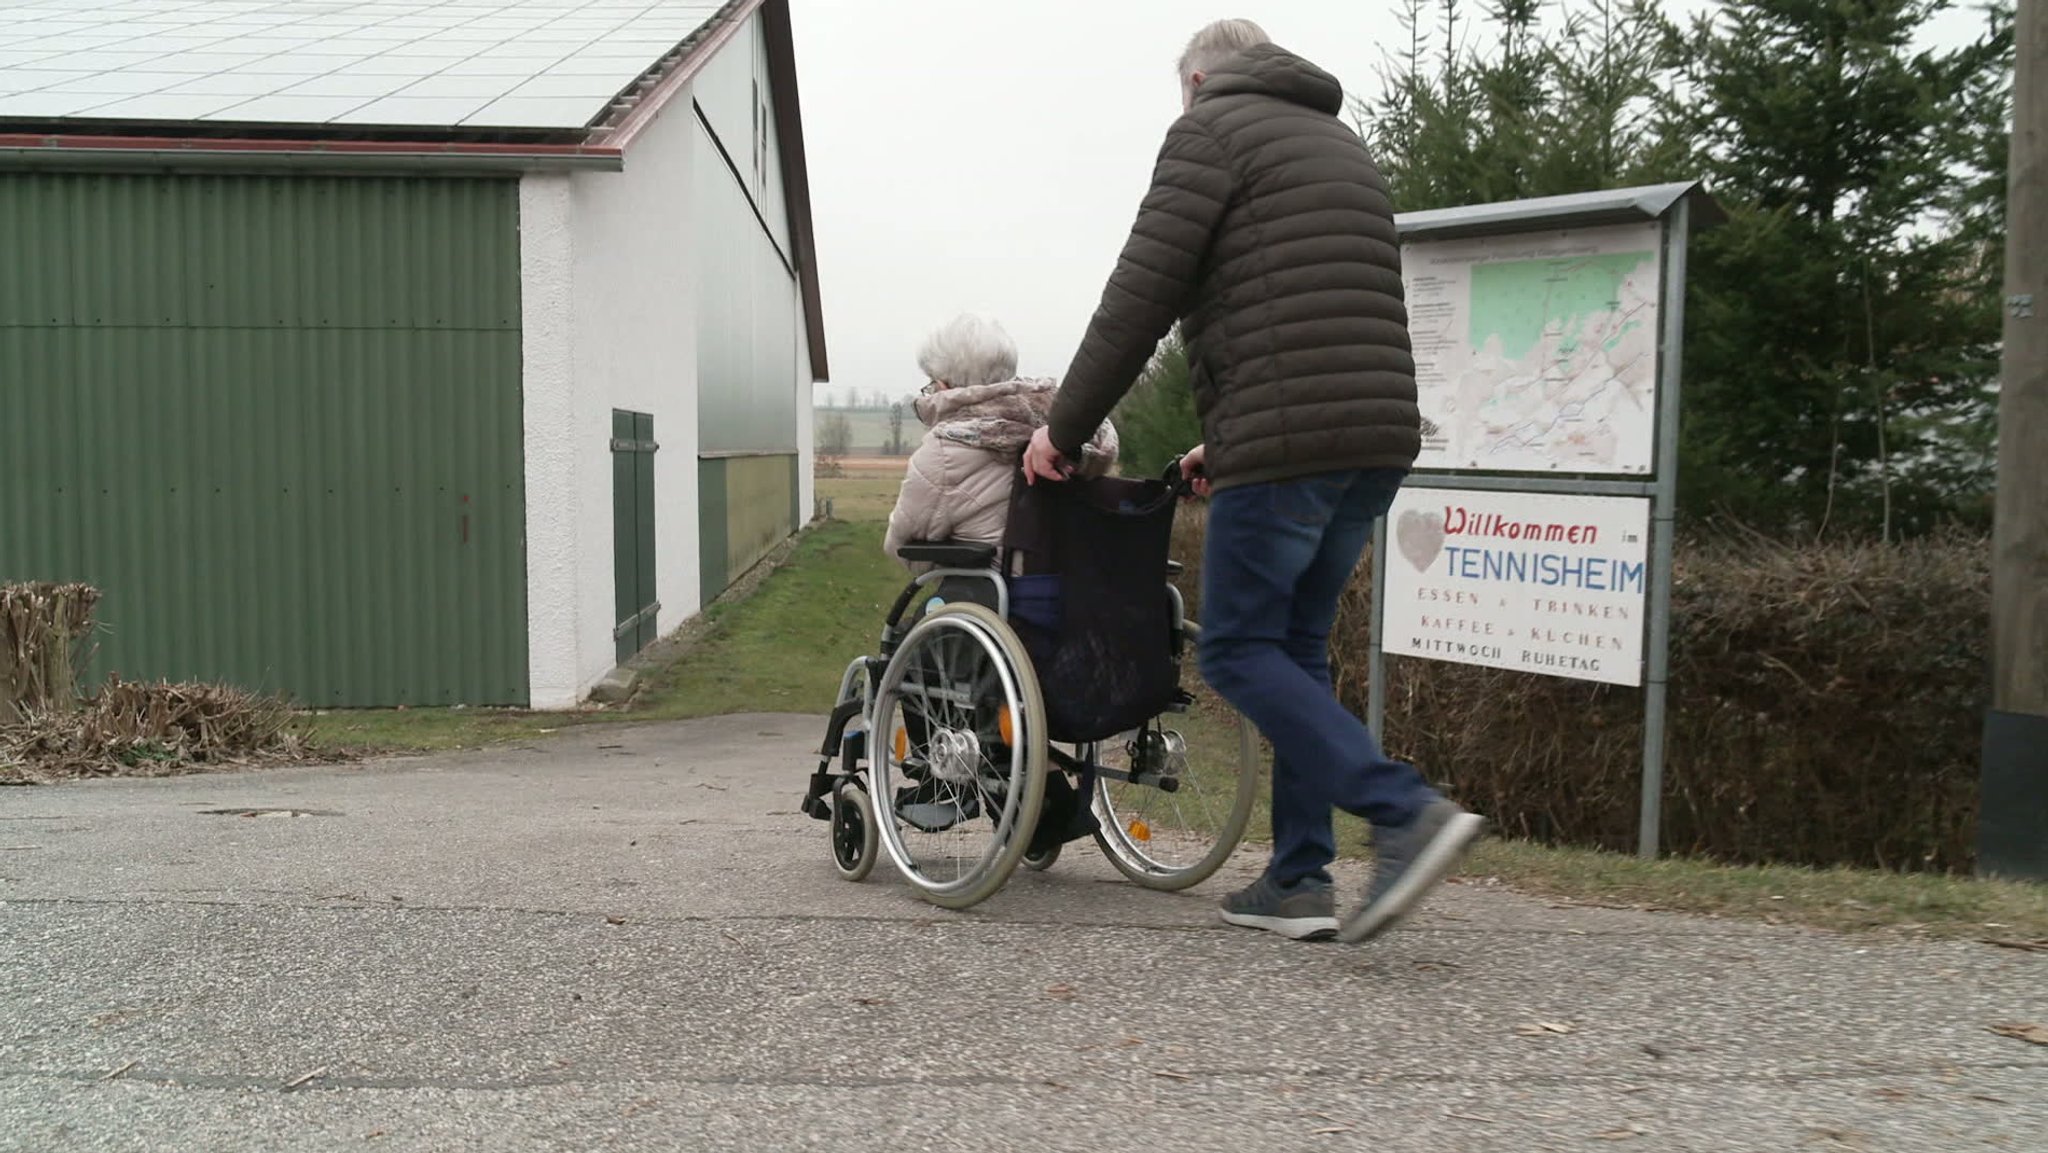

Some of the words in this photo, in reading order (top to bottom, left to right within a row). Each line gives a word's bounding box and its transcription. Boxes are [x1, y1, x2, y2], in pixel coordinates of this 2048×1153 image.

[1443, 506, 1597, 544] Willkommen
[1622, 530, 1638, 543] im
[1445, 547, 1643, 594] TENNISHEIM
[1418, 587, 1478, 604] ESSEN
[1533, 599, 1628, 619] TRINKEN
[1421, 615, 1493, 635] KAFFEE
[1411, 637, 1501, 659] MITTWOCH
[1521, 649, 1600, 671] RUHETAG
